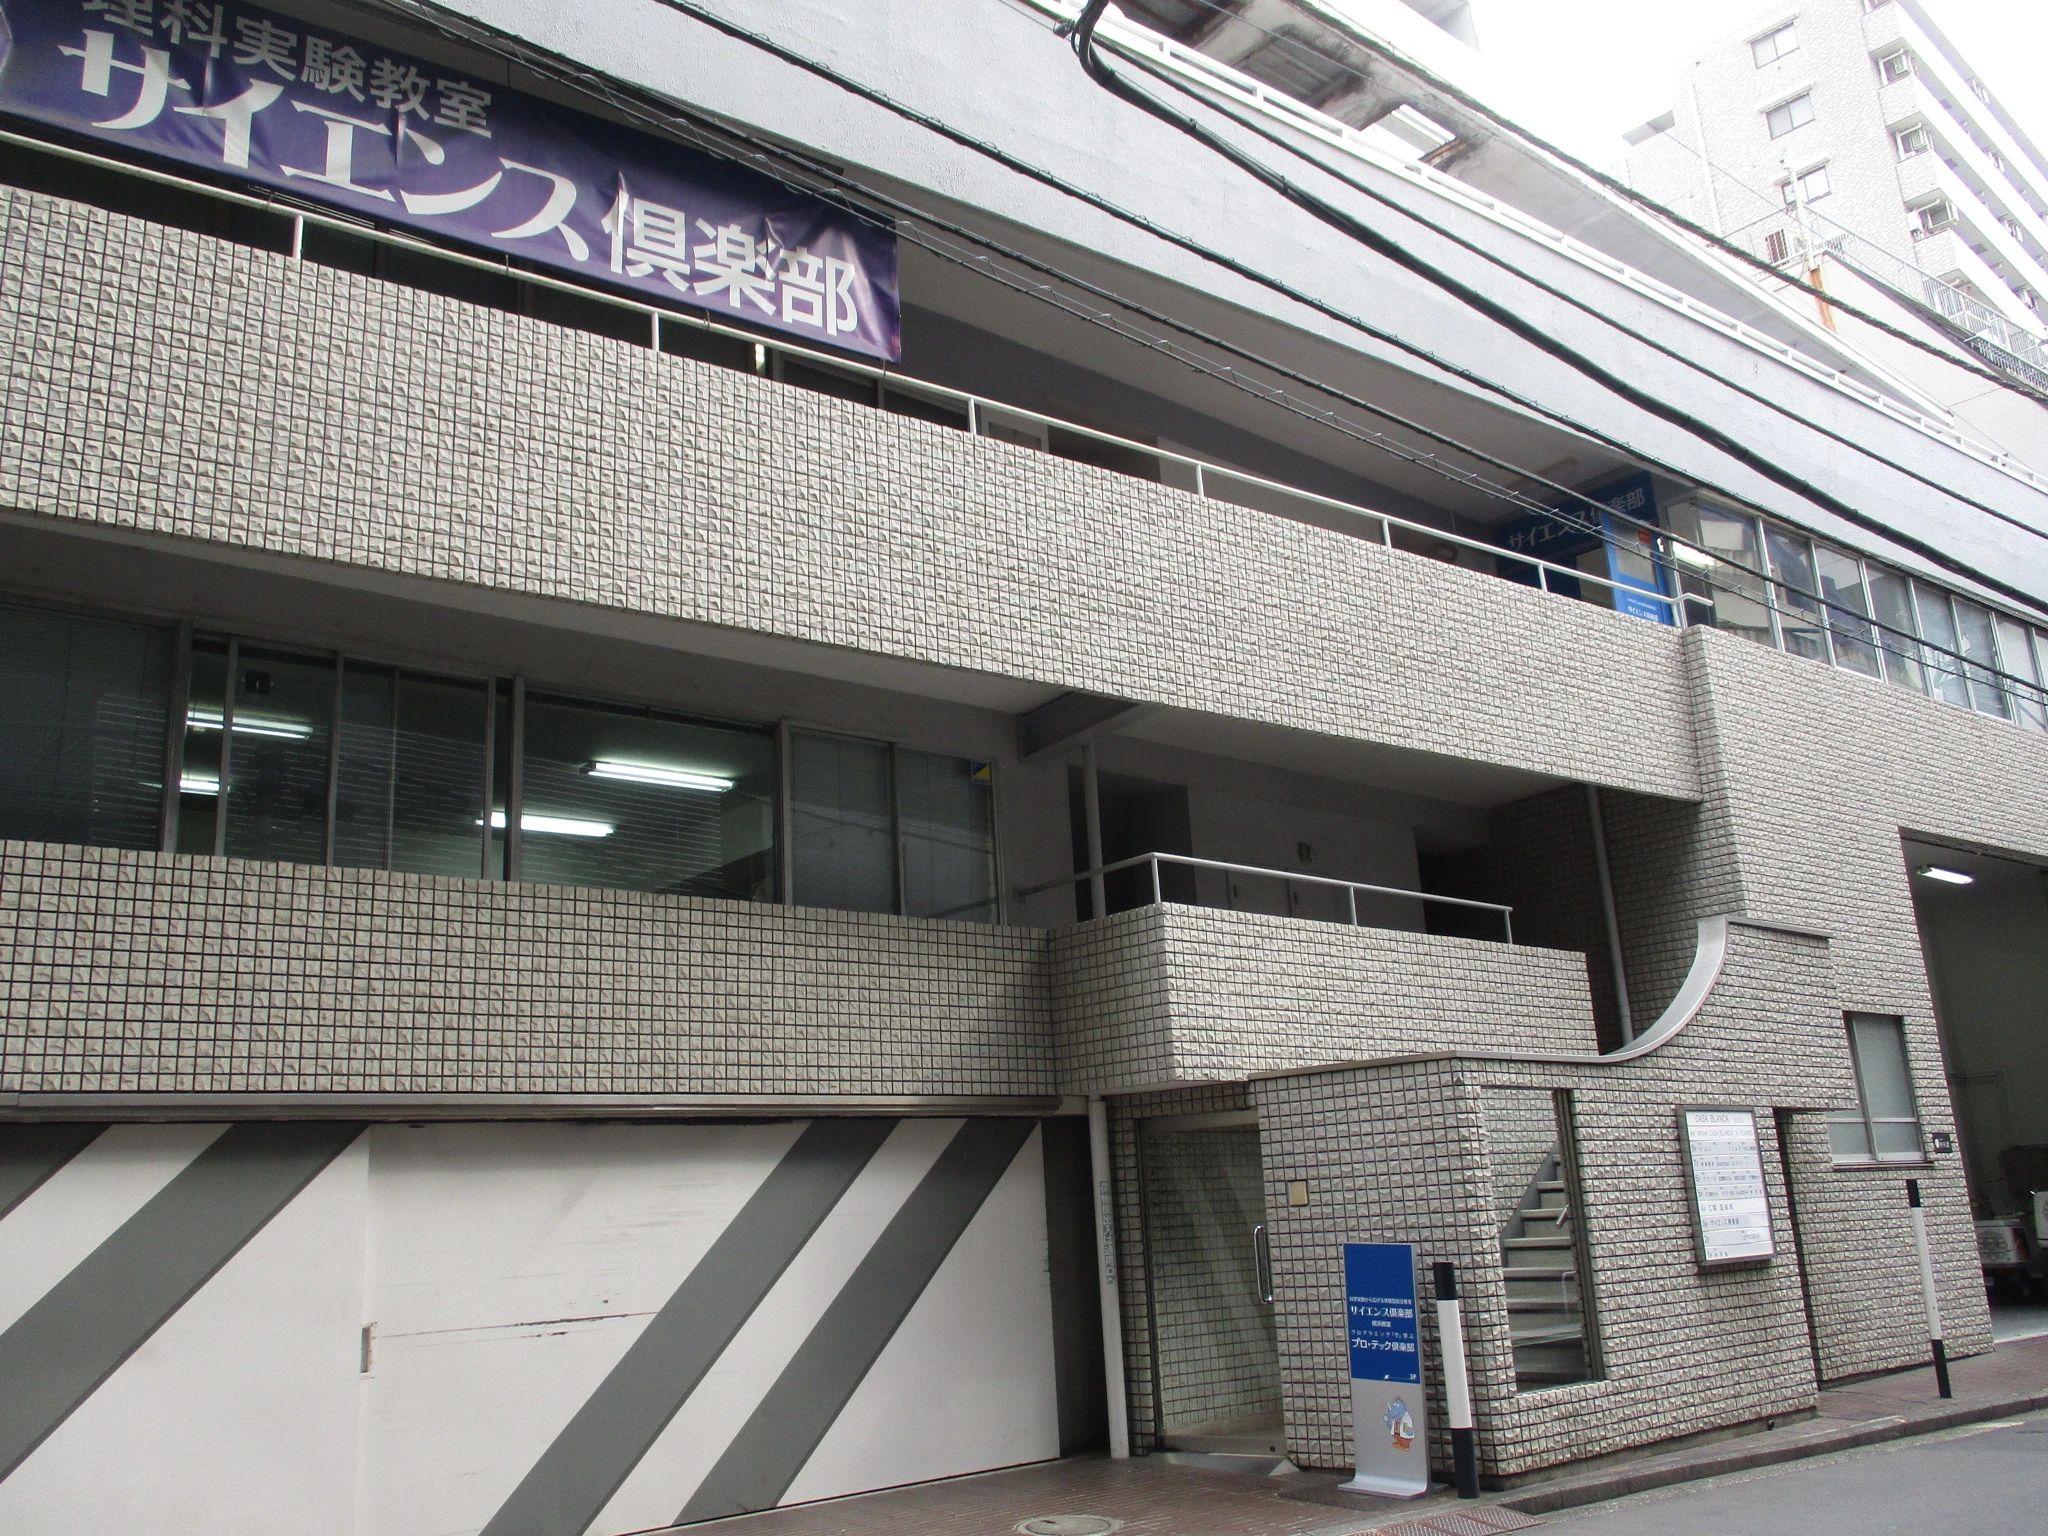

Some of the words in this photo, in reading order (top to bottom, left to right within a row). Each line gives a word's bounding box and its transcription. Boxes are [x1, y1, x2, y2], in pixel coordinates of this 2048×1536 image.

[82, 0, 492, 139] 理科実験教室
[57, 28, 860, 337] サイエンス倶楽部
[1351, 1306, 1413, 1318] サイエンス倶楽部
